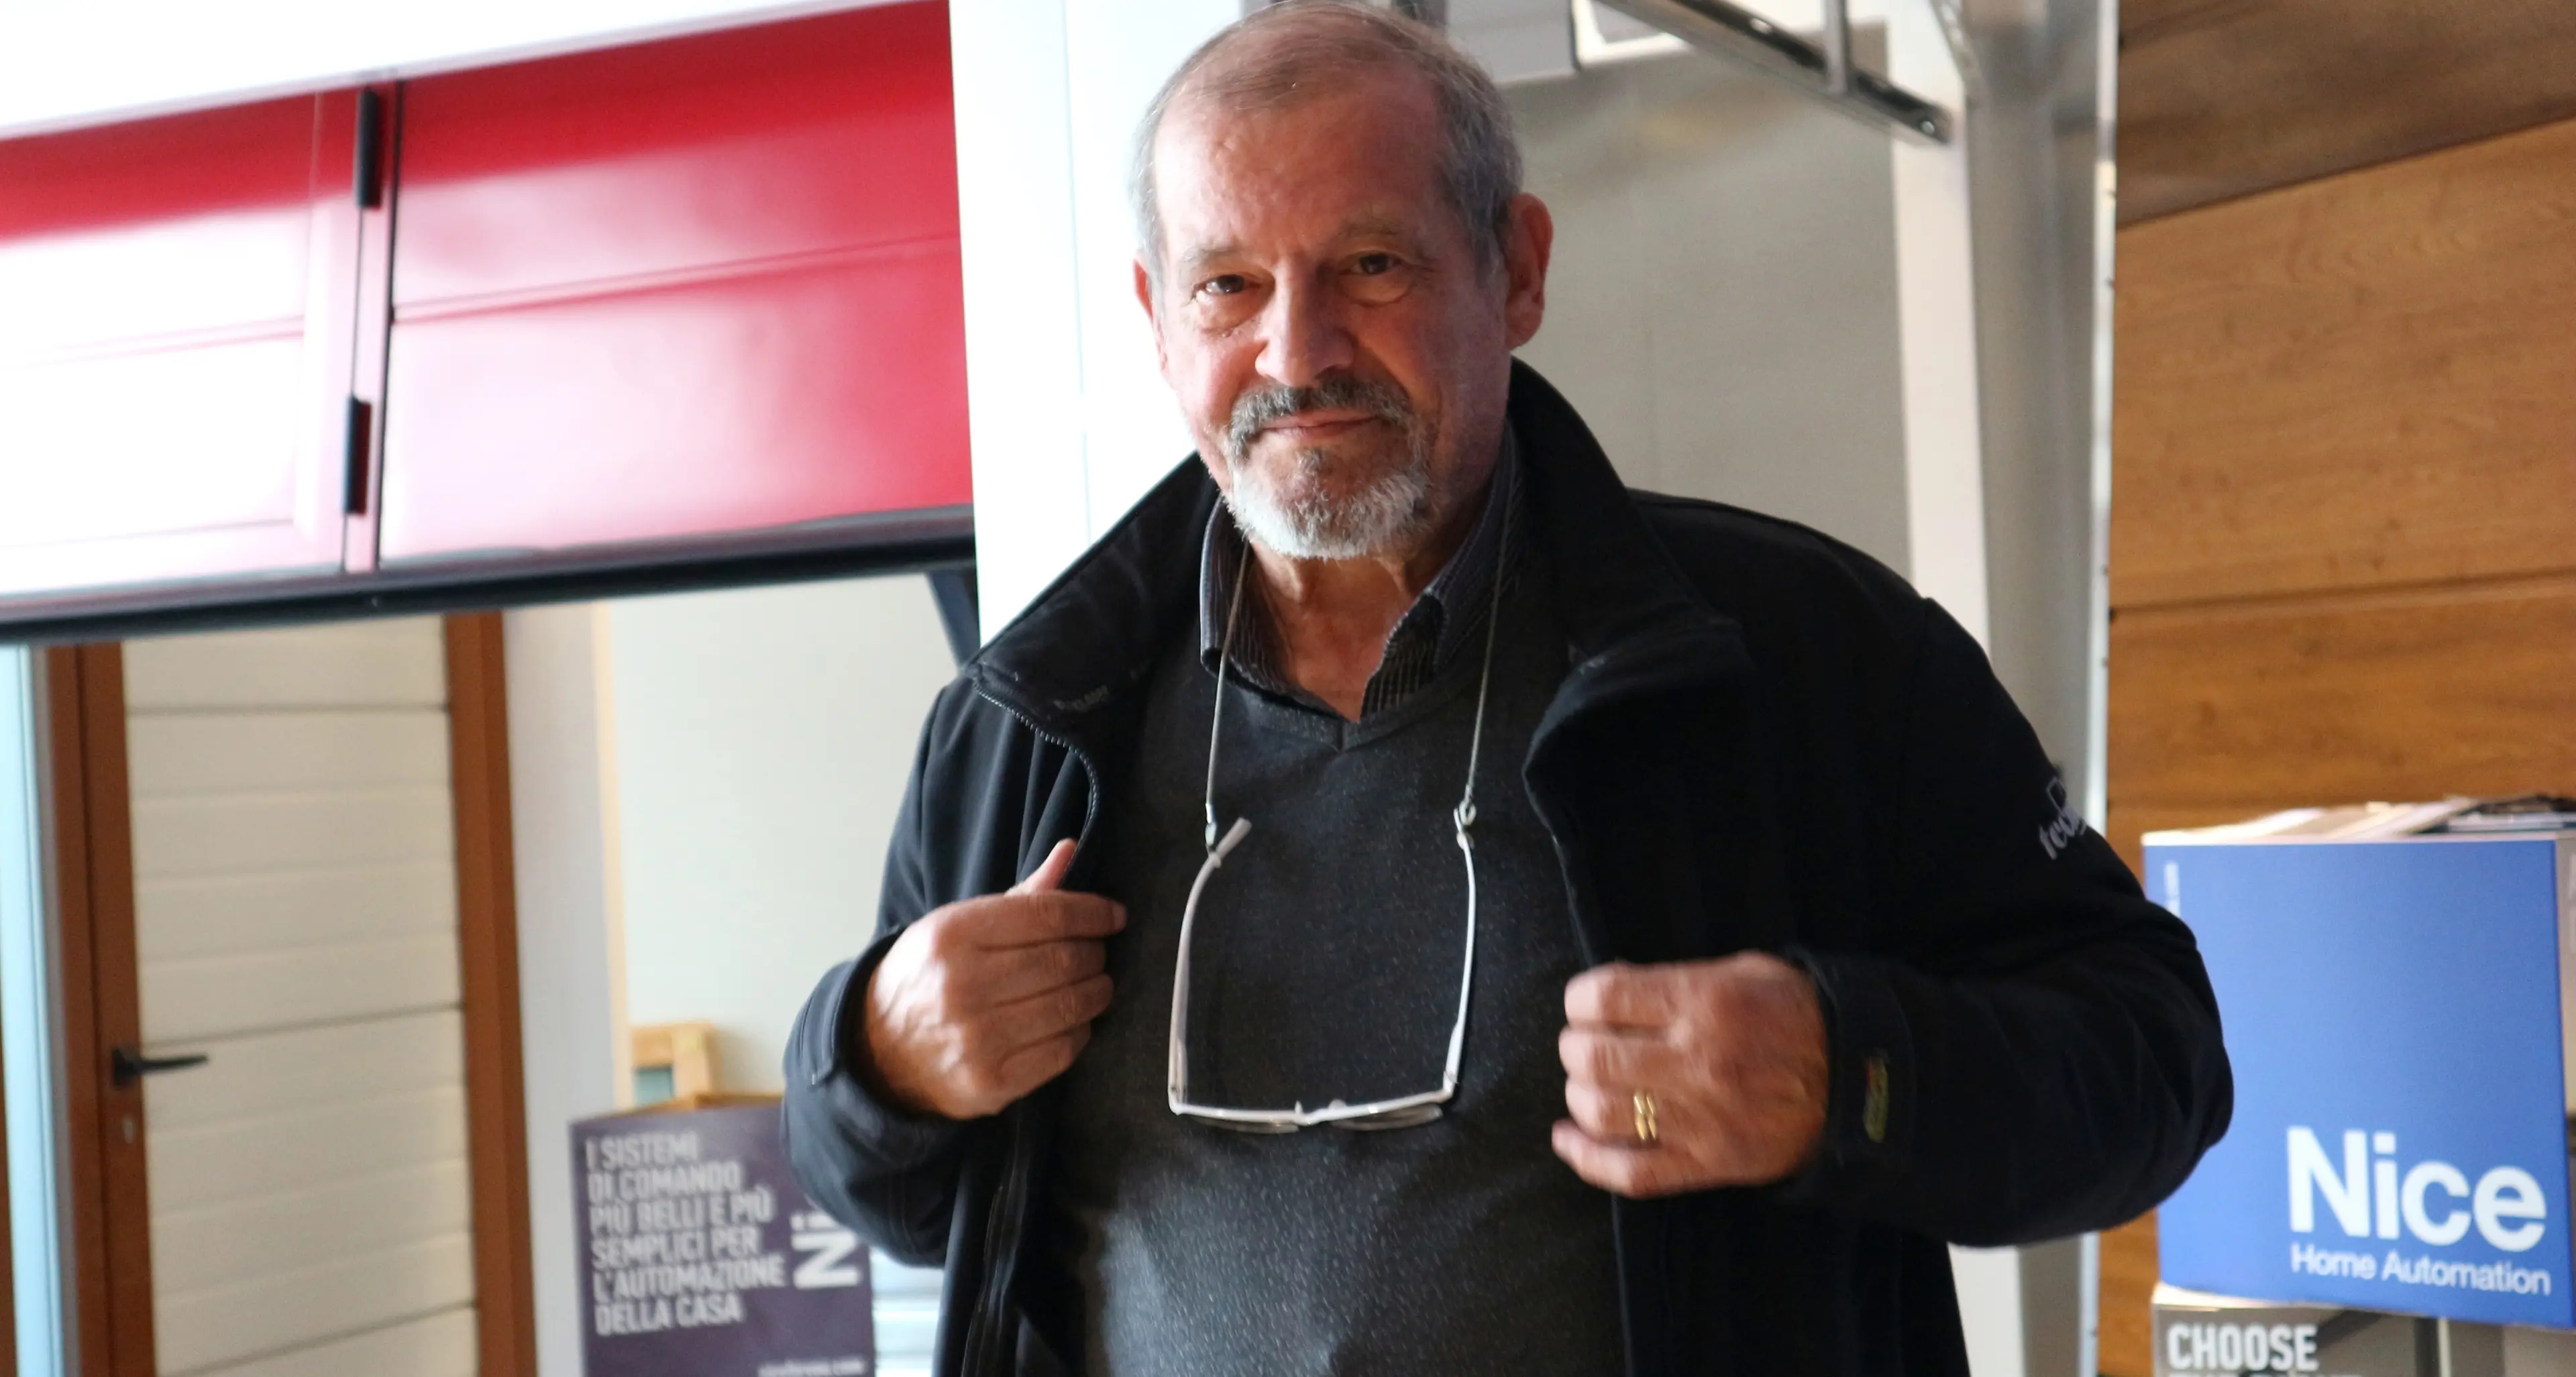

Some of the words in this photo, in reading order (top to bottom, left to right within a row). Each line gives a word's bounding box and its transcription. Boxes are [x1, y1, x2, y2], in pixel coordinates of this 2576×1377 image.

[585, 1138, 596, 1170] I
[601, 1131, 698, 1168] SISTEMI
[588, 1171, 613, 1203] DI
[619, 1162, 742, 1200] COMANDO
[2286, 1126, 2546, 1252] Nice
[590, 1198, 631, 1234] PIÙ
[637, 1195, 705, 1231] BELLI
[710, 1193, 725, 1225] E
[731, 1185, 774, 1223] PIÙ
[591, 1231, 705, 1270] SEMPLICI
[711, 1226, 760, 1257] PER
[2291, 1242, 2377, 1279] Home
[2381, 1250, 2551, 1297] Automation
[593, 1255, 785, 1303] L'AUTOMAZIONE
[595, 1299, 671, 1336] DELLA
[676, 1292, 743, 1327] CASA
[2167, 1322, 2320, 1371] CHOOSE
